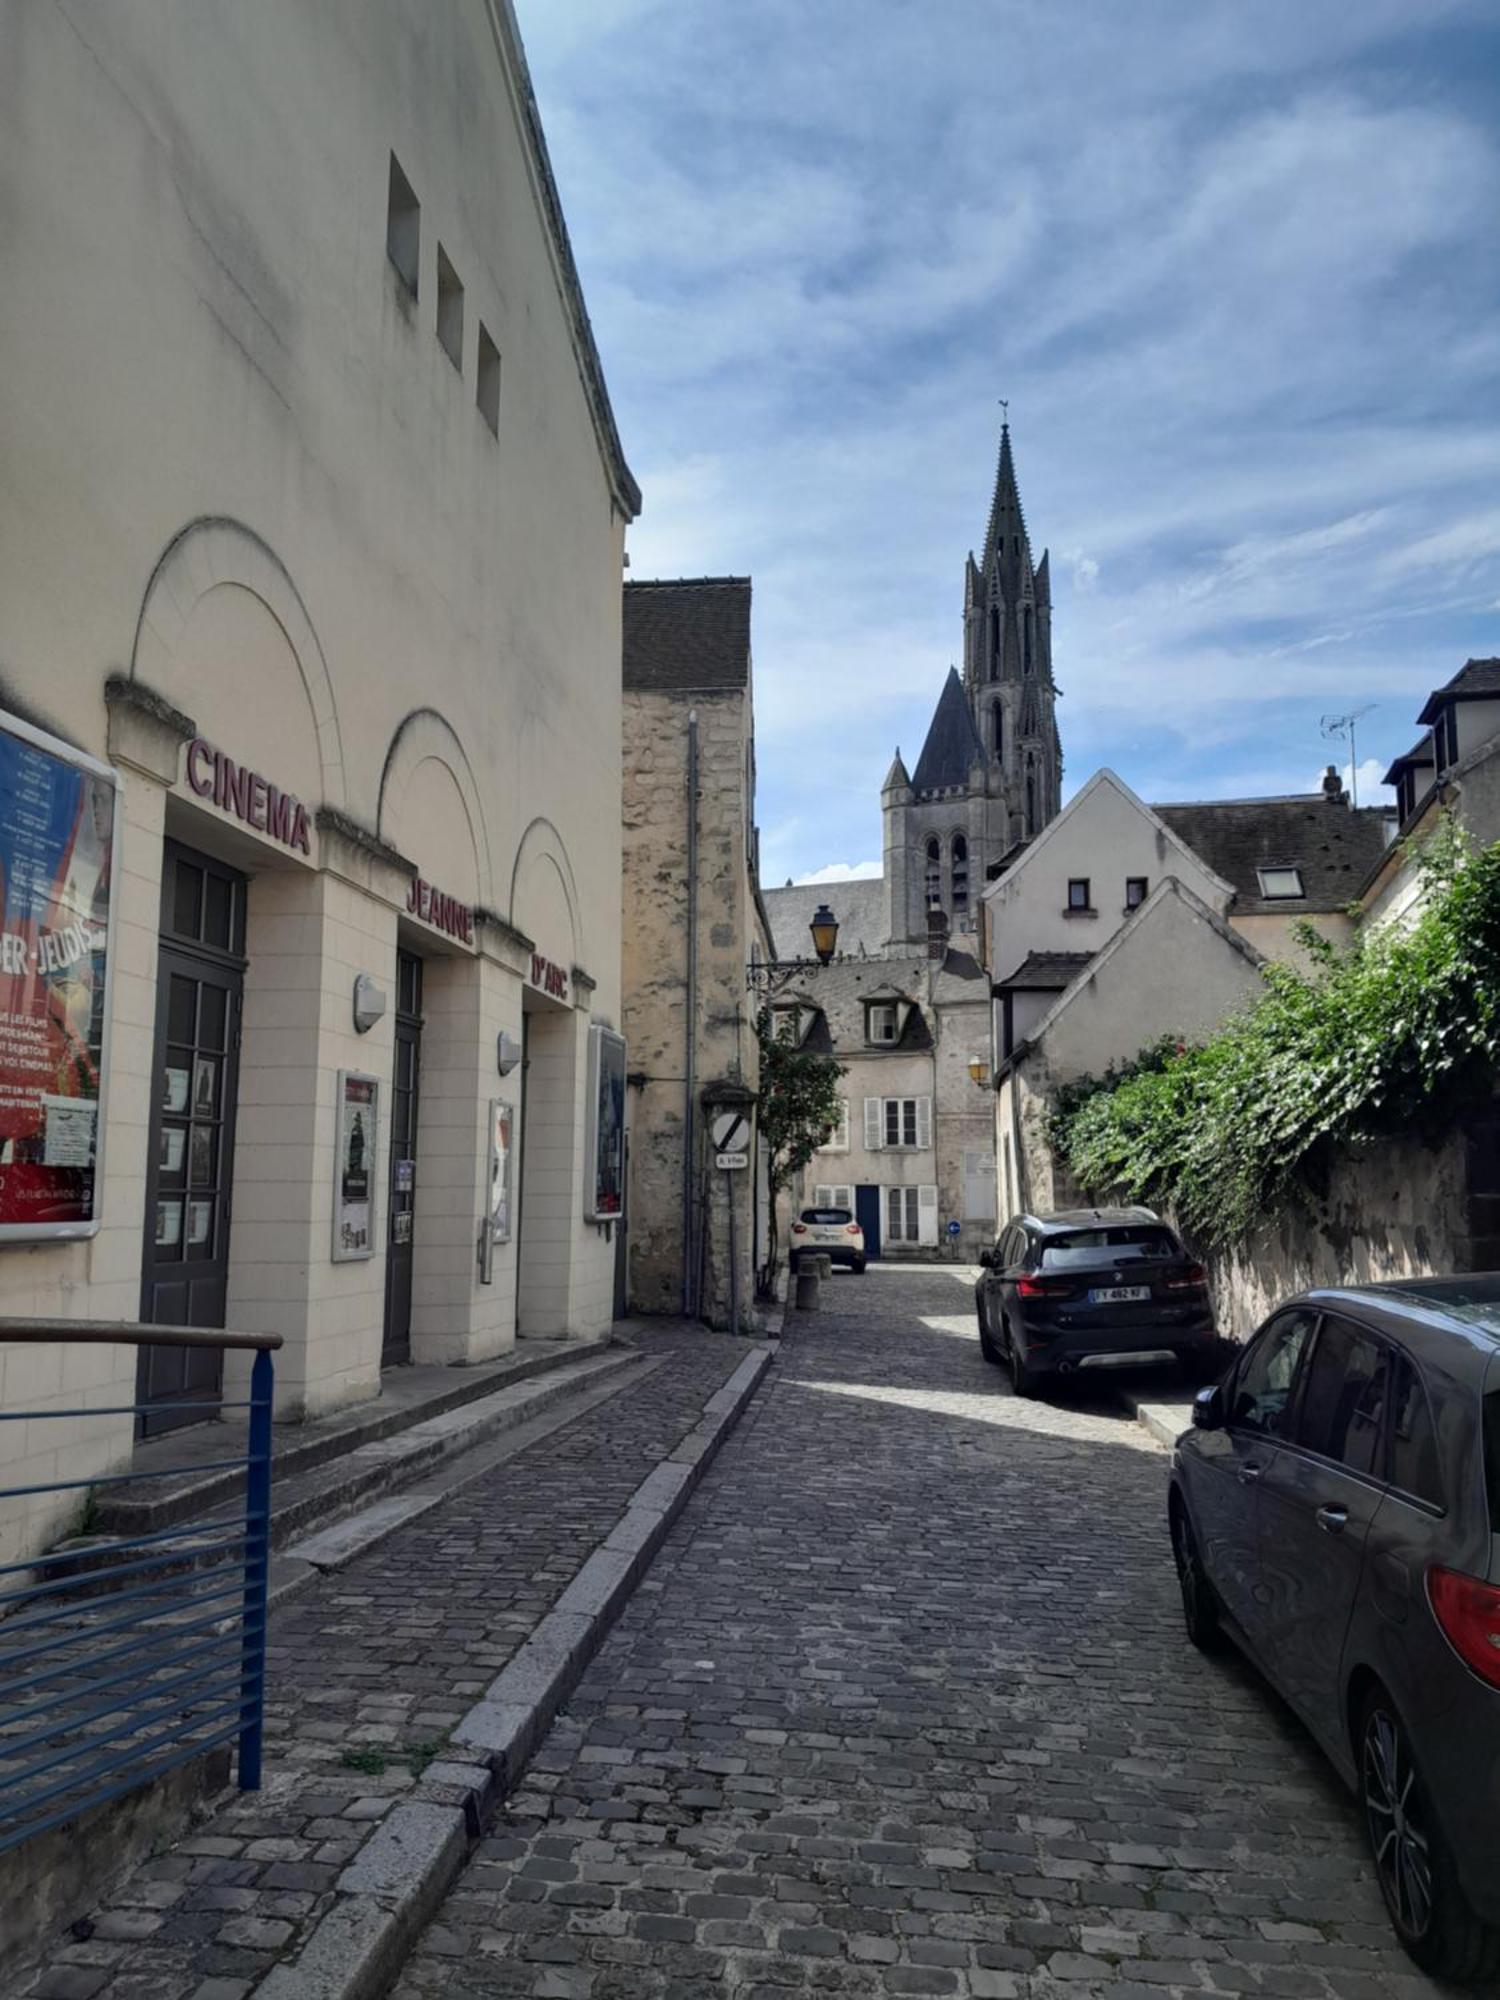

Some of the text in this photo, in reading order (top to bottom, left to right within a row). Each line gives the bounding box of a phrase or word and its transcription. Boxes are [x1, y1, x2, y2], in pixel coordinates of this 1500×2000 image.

[187, 737, 310, 857] CINEMA
[407, 879, 474, 946] JEANNE
[0, 916, 92, 976] ER-JEUDIS
[531, 953, 568, 1000] D'ARC
